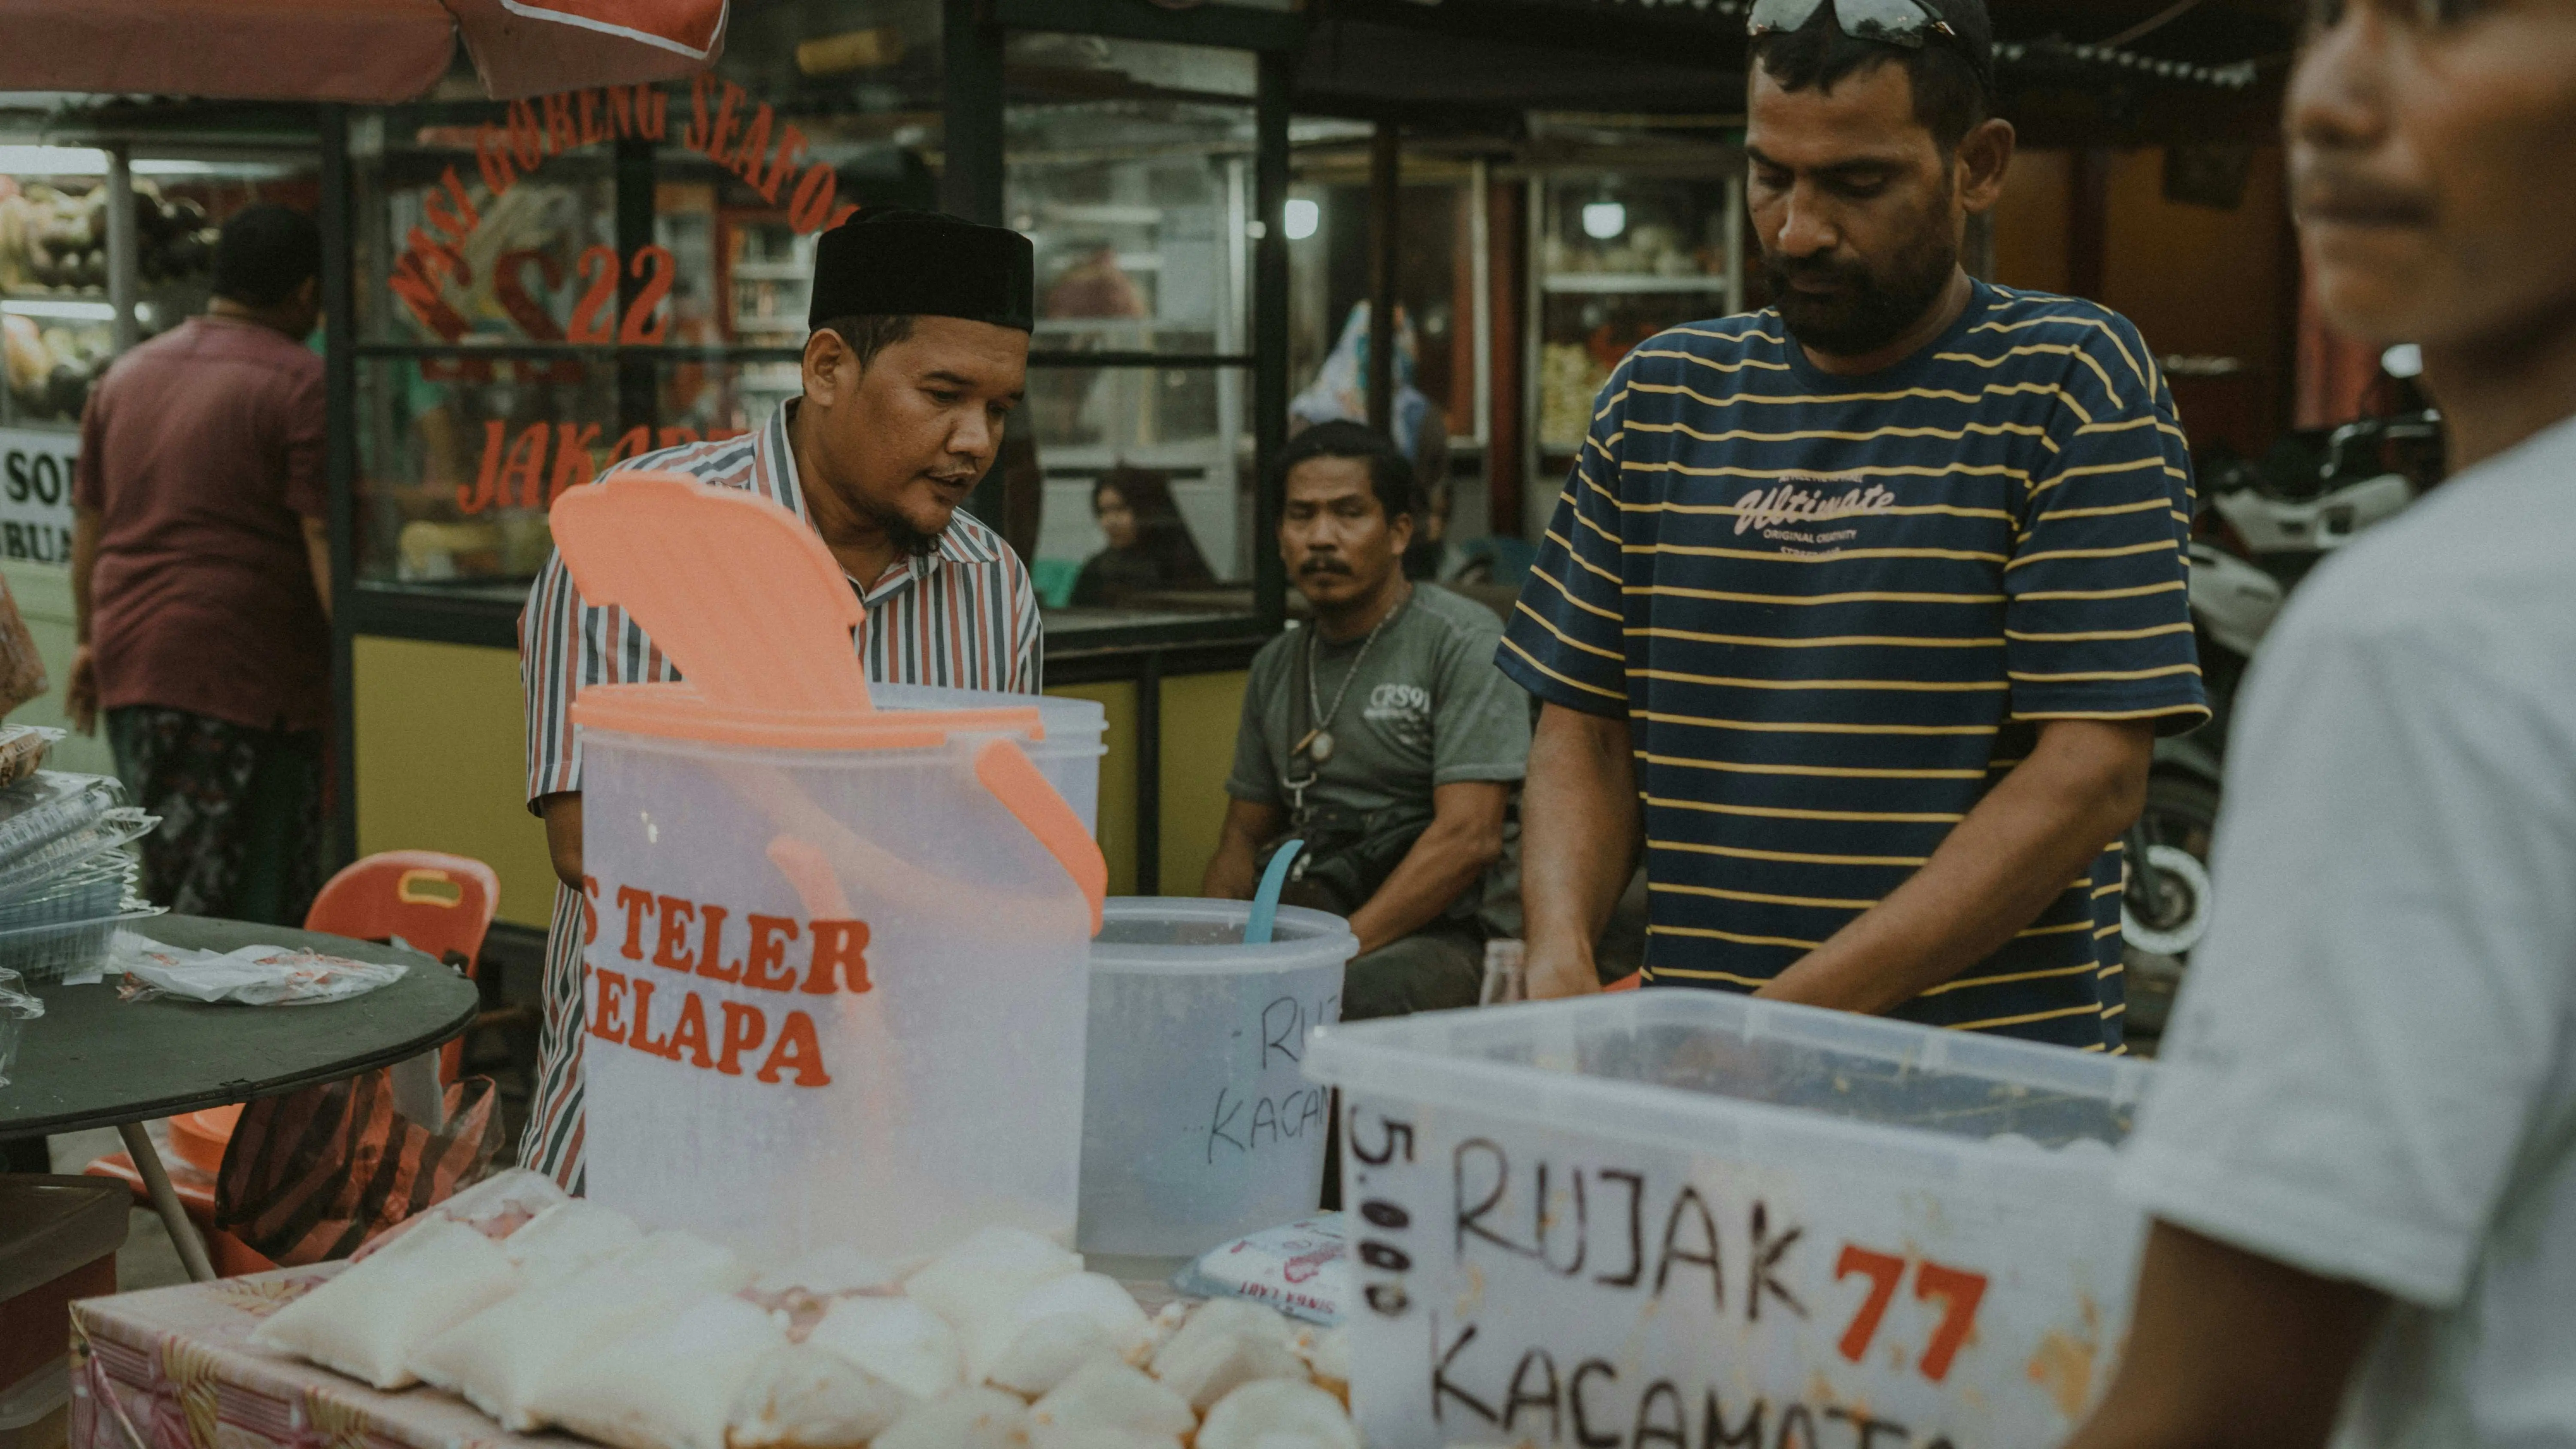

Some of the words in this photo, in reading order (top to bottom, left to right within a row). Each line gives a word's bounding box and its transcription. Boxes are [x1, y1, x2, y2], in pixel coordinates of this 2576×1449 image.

[389, 163, 480, 327] NASI
[475, 82, 668, 197] GORENG
[683, 69, 861, 237] SEAFO
[565, 243, 675, 345] 22
[457, 418, 750, 514] JAK
[1733, 483, 1896, 536] Ultimate
[1762, 529, 1815, 544] ORIGINAL
[617, 884, 874, 995] TELER
[584, 962, 832, 1088] ELAPA
[1261, 996, 1337, 1070] RU
[1349, 1103, 1413, 1318] 5.000
[1452, 1136, 1810, 1323] RUJAK
[1834, 1242, 1990, 1385] 77
[1431, 1309, 1956, 1449] KACAMAT
